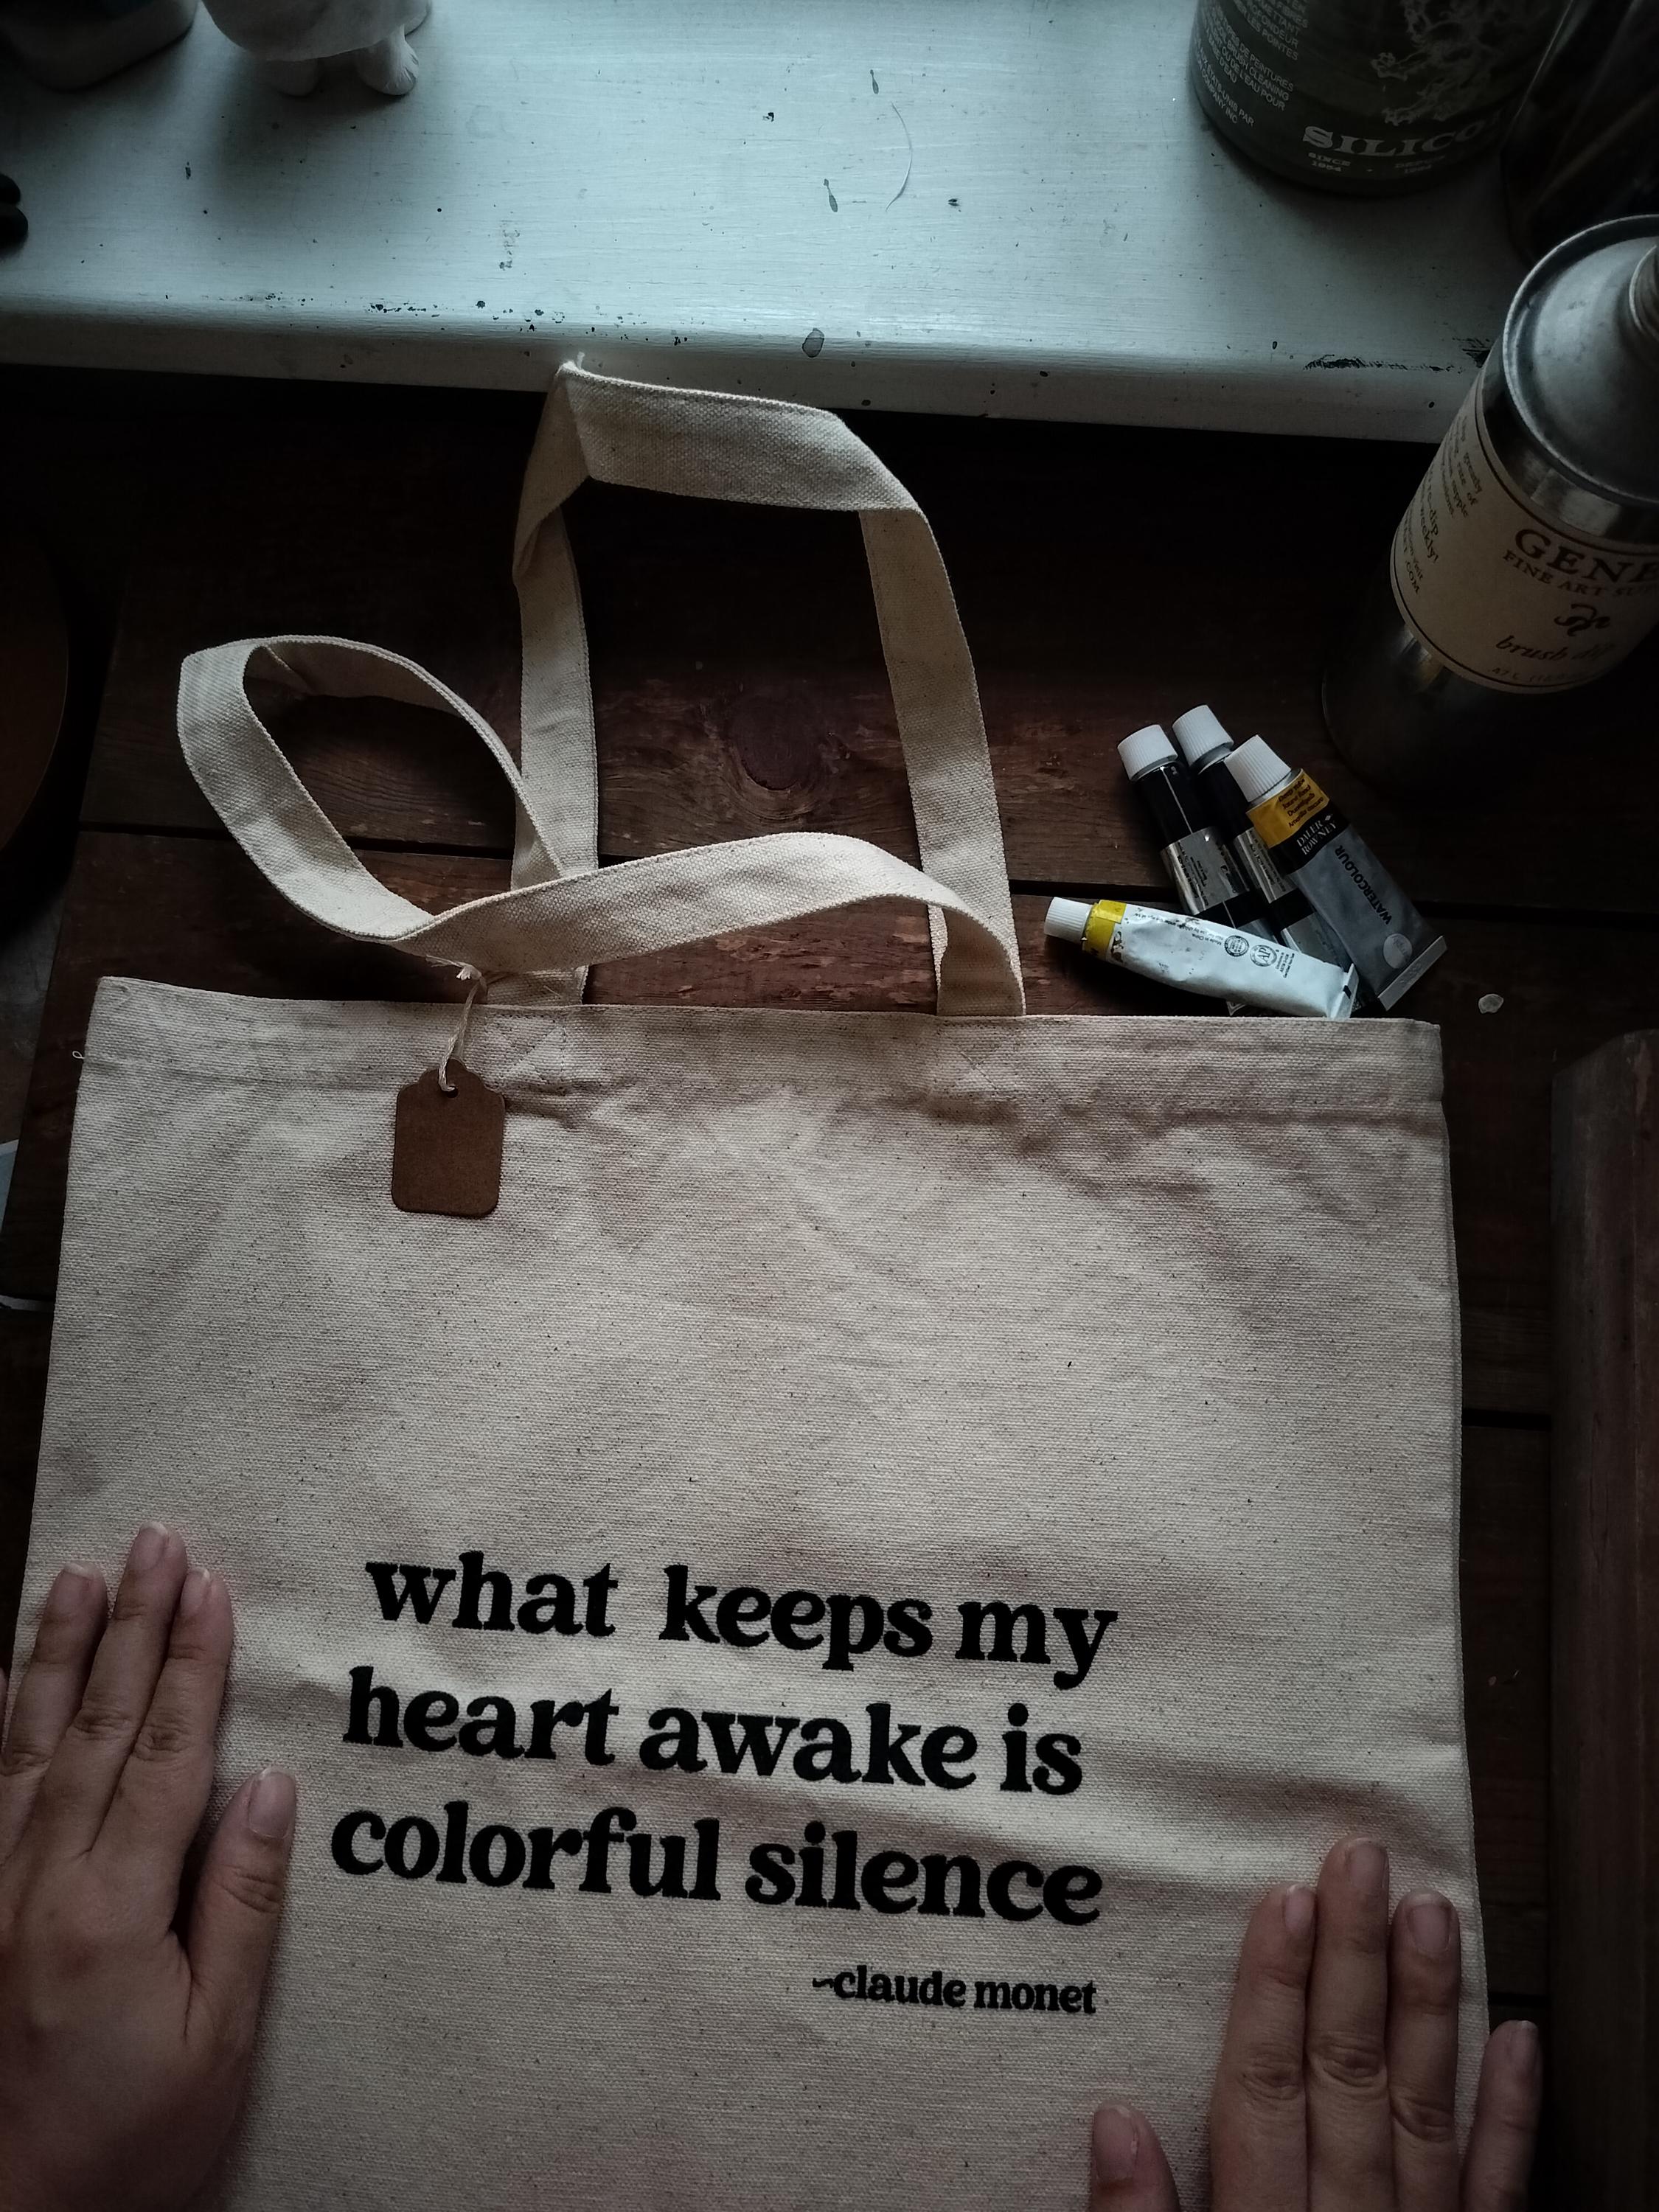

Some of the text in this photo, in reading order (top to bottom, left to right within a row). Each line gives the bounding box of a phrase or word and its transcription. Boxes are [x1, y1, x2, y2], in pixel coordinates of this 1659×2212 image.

[1249, 66, 1290, 101] CLEANING
[1250, 53, 1294, 92] PEINTURES
[1238, 108, 1255, 128] PAR
[1260, 89, 1286, 111] POUR
[1503, 549, 1554, 585] FINE
[1495, 635, 1569, 661] brush
[1296, 820, 1324, 847] DALER
[1300, 821, 1338, 856] ROWNEY
[1335, 845, 1392, 925] WATERCOLOUR
[365, 1551, 1119, 1690] what keeps my
[342, 1666, 1083, 1795] heart awake is
[331, 1801, 1102, 1926] colorful silence
[973, 1975, 1096, 2014] monet
